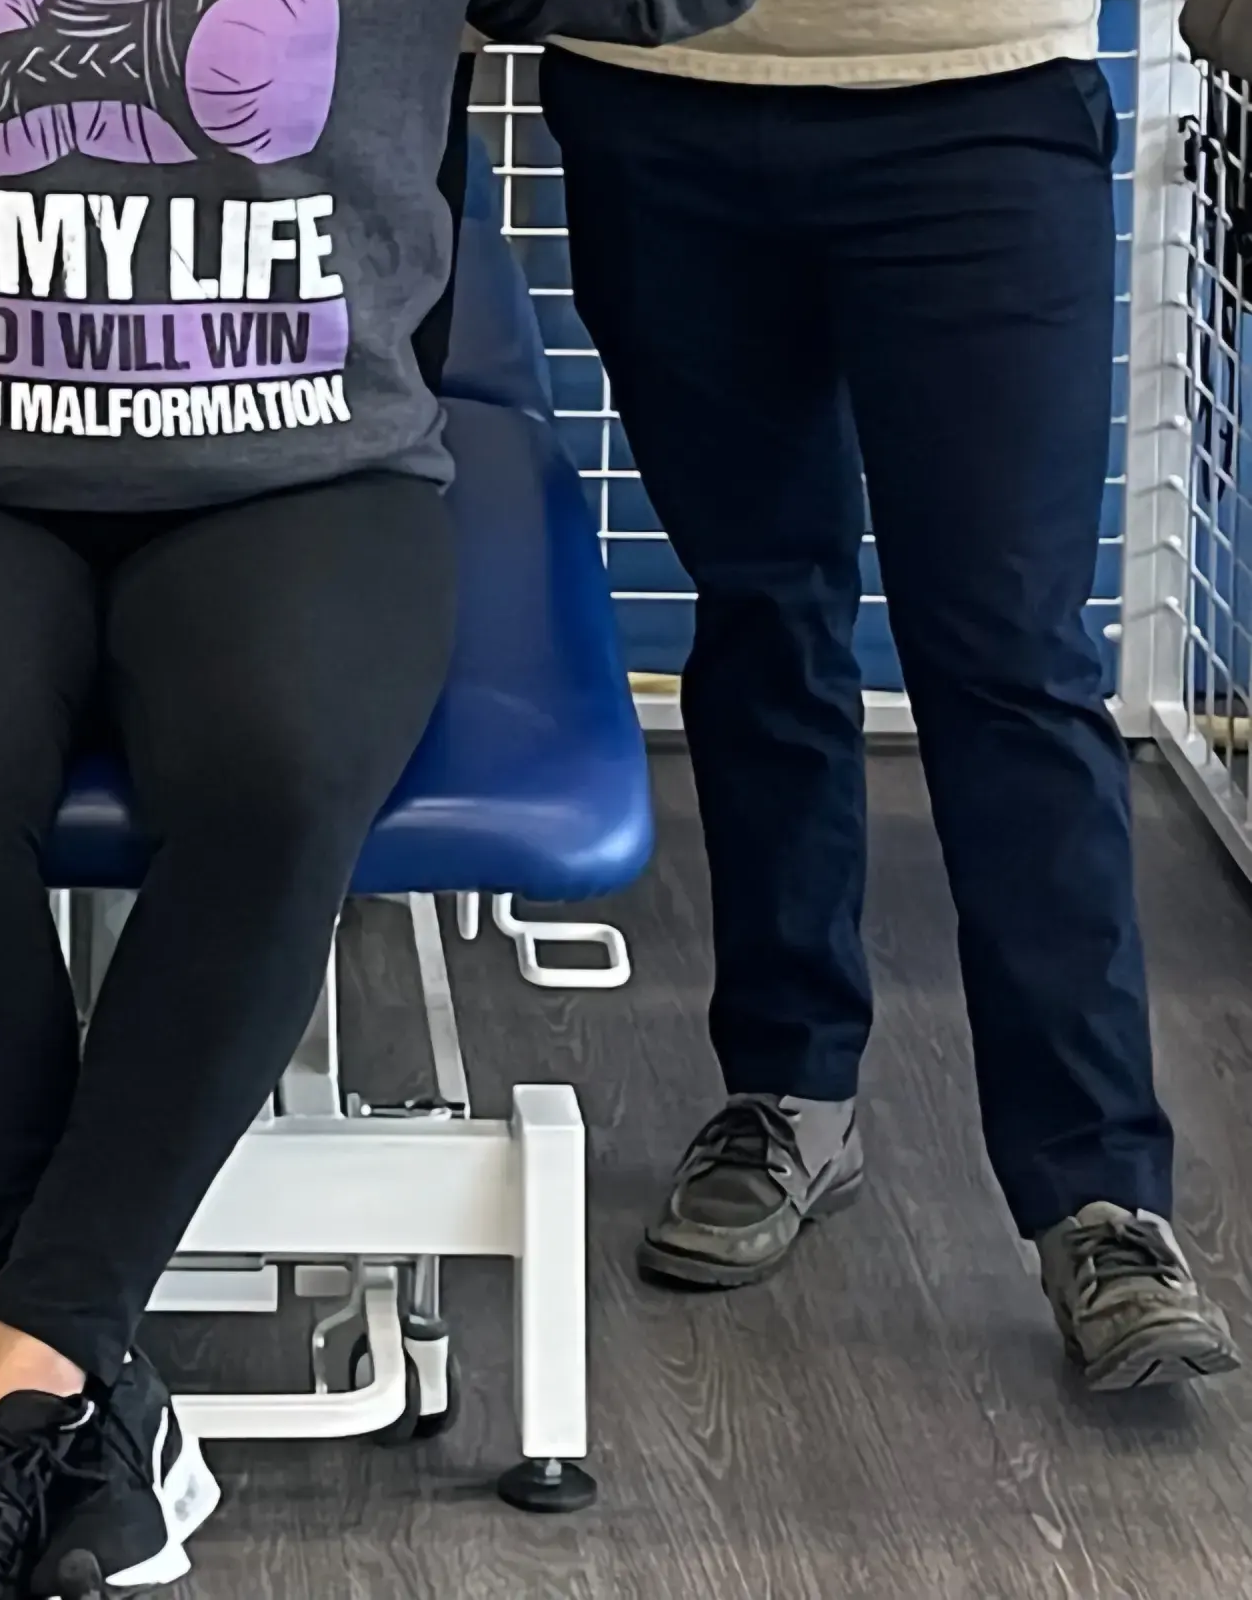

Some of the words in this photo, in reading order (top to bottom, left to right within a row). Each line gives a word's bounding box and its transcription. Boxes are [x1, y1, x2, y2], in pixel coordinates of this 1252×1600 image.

[169, 194, 344, 301] LIFE
[30, 309, 45, 368] I
[57, 311, 191, 372] WILL
[201, 311, 310, 369] WIN
[10, 374, 351, 438] MALFORMATION
